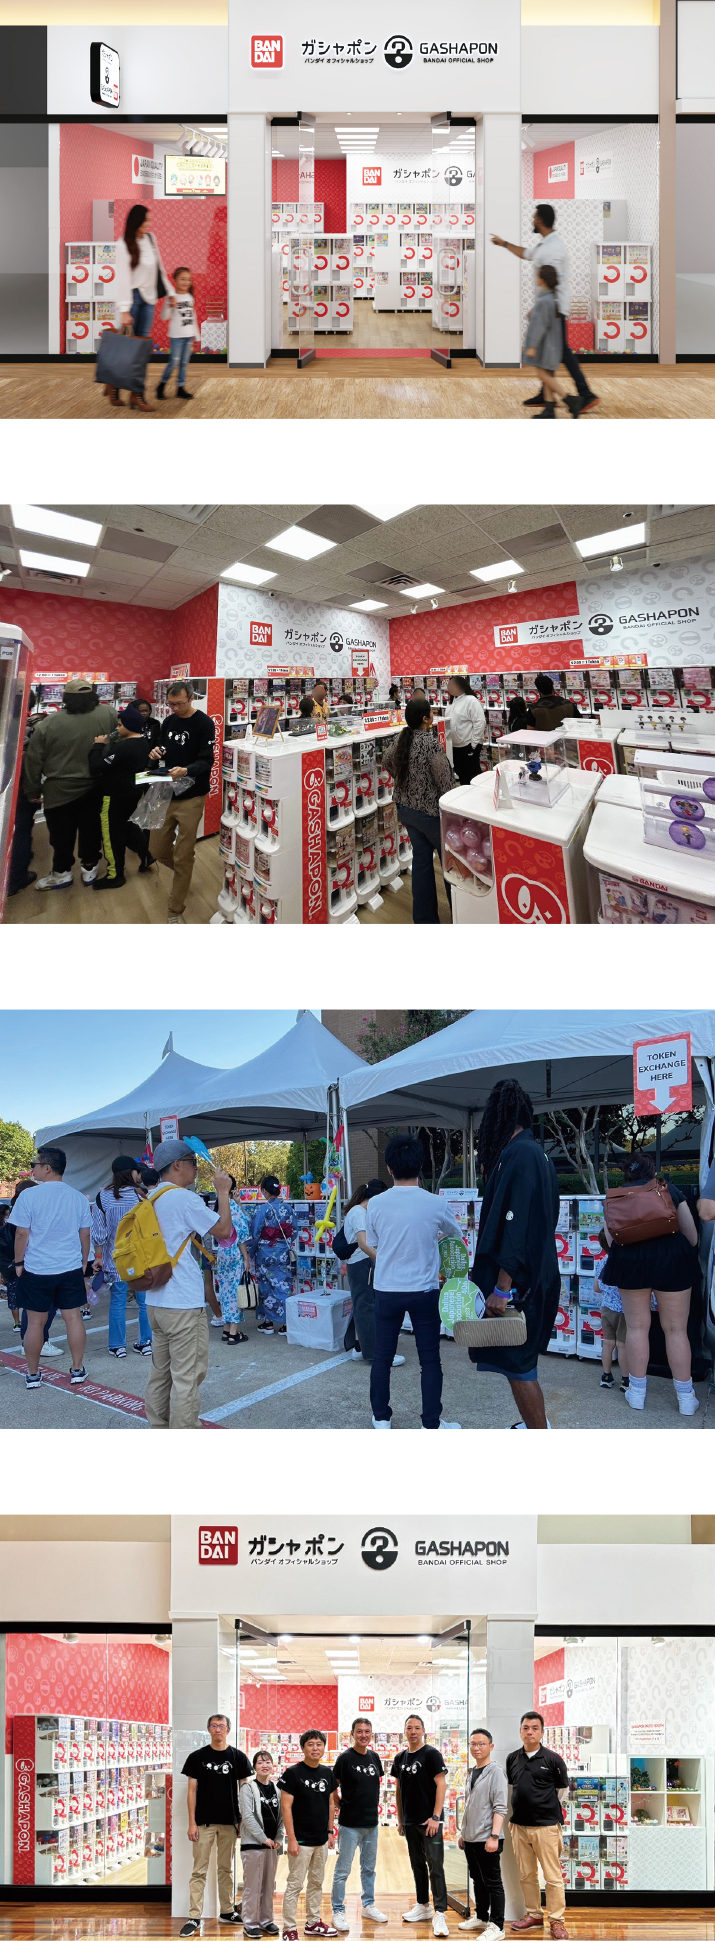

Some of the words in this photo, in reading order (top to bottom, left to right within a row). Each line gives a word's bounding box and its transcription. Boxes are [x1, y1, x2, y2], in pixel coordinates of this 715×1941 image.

[255, 41, 281, 52] BAN
[302, 39, 377, 56] ガシャポン
[419, 42, 498, 55] GASHAPON
[255, 51, 276, 63] DAI
[365, 168, 381, 177] BAN
[393, 168, 440, 179] ガシャポン
[365, 176, 378, 184] DAI
[618, 607, 700, 625] GASHAPON
[252, 624, 271, 635] BAN
[529, 621, 584, 636] ガシャポン
[646, 620, 676, 628] OFFICIAL
[252, 634, 268, 644] DAI
[285, 628, 327, 643] ガシャポン
[501, 628, 517, 637] BAN
[346, 637, 377, 648] GASHAPON
[501, 635, 514, 644] DAI
[308, 789, 322, 917] GASHAPON
[640, 878, 668, 891] BANDAI
[647, 1051, 676, 1061] TOKEN
[638, 1059, 686, 1073] EXCHANGE
[650, 1072, 673, 1081] HERE
[441, 1291, 449, 1313] Dallas
[447, 1291, 457, 1324] Japanese
[77, 1384, 101, 1394] NO
[92, 1389, 146, 1411] PARKING
[201, 1530, 236, 1545] BAN
[201, 1545, 229, 1559] DAI
[248, 1534, 345, 1557] ガシャポン
[415, 1540, 509, 1557] GASHAPON
[384, 1697, 423, 1706] ガシャポン
[18, 1772, 31, 1852] GASHAPON
